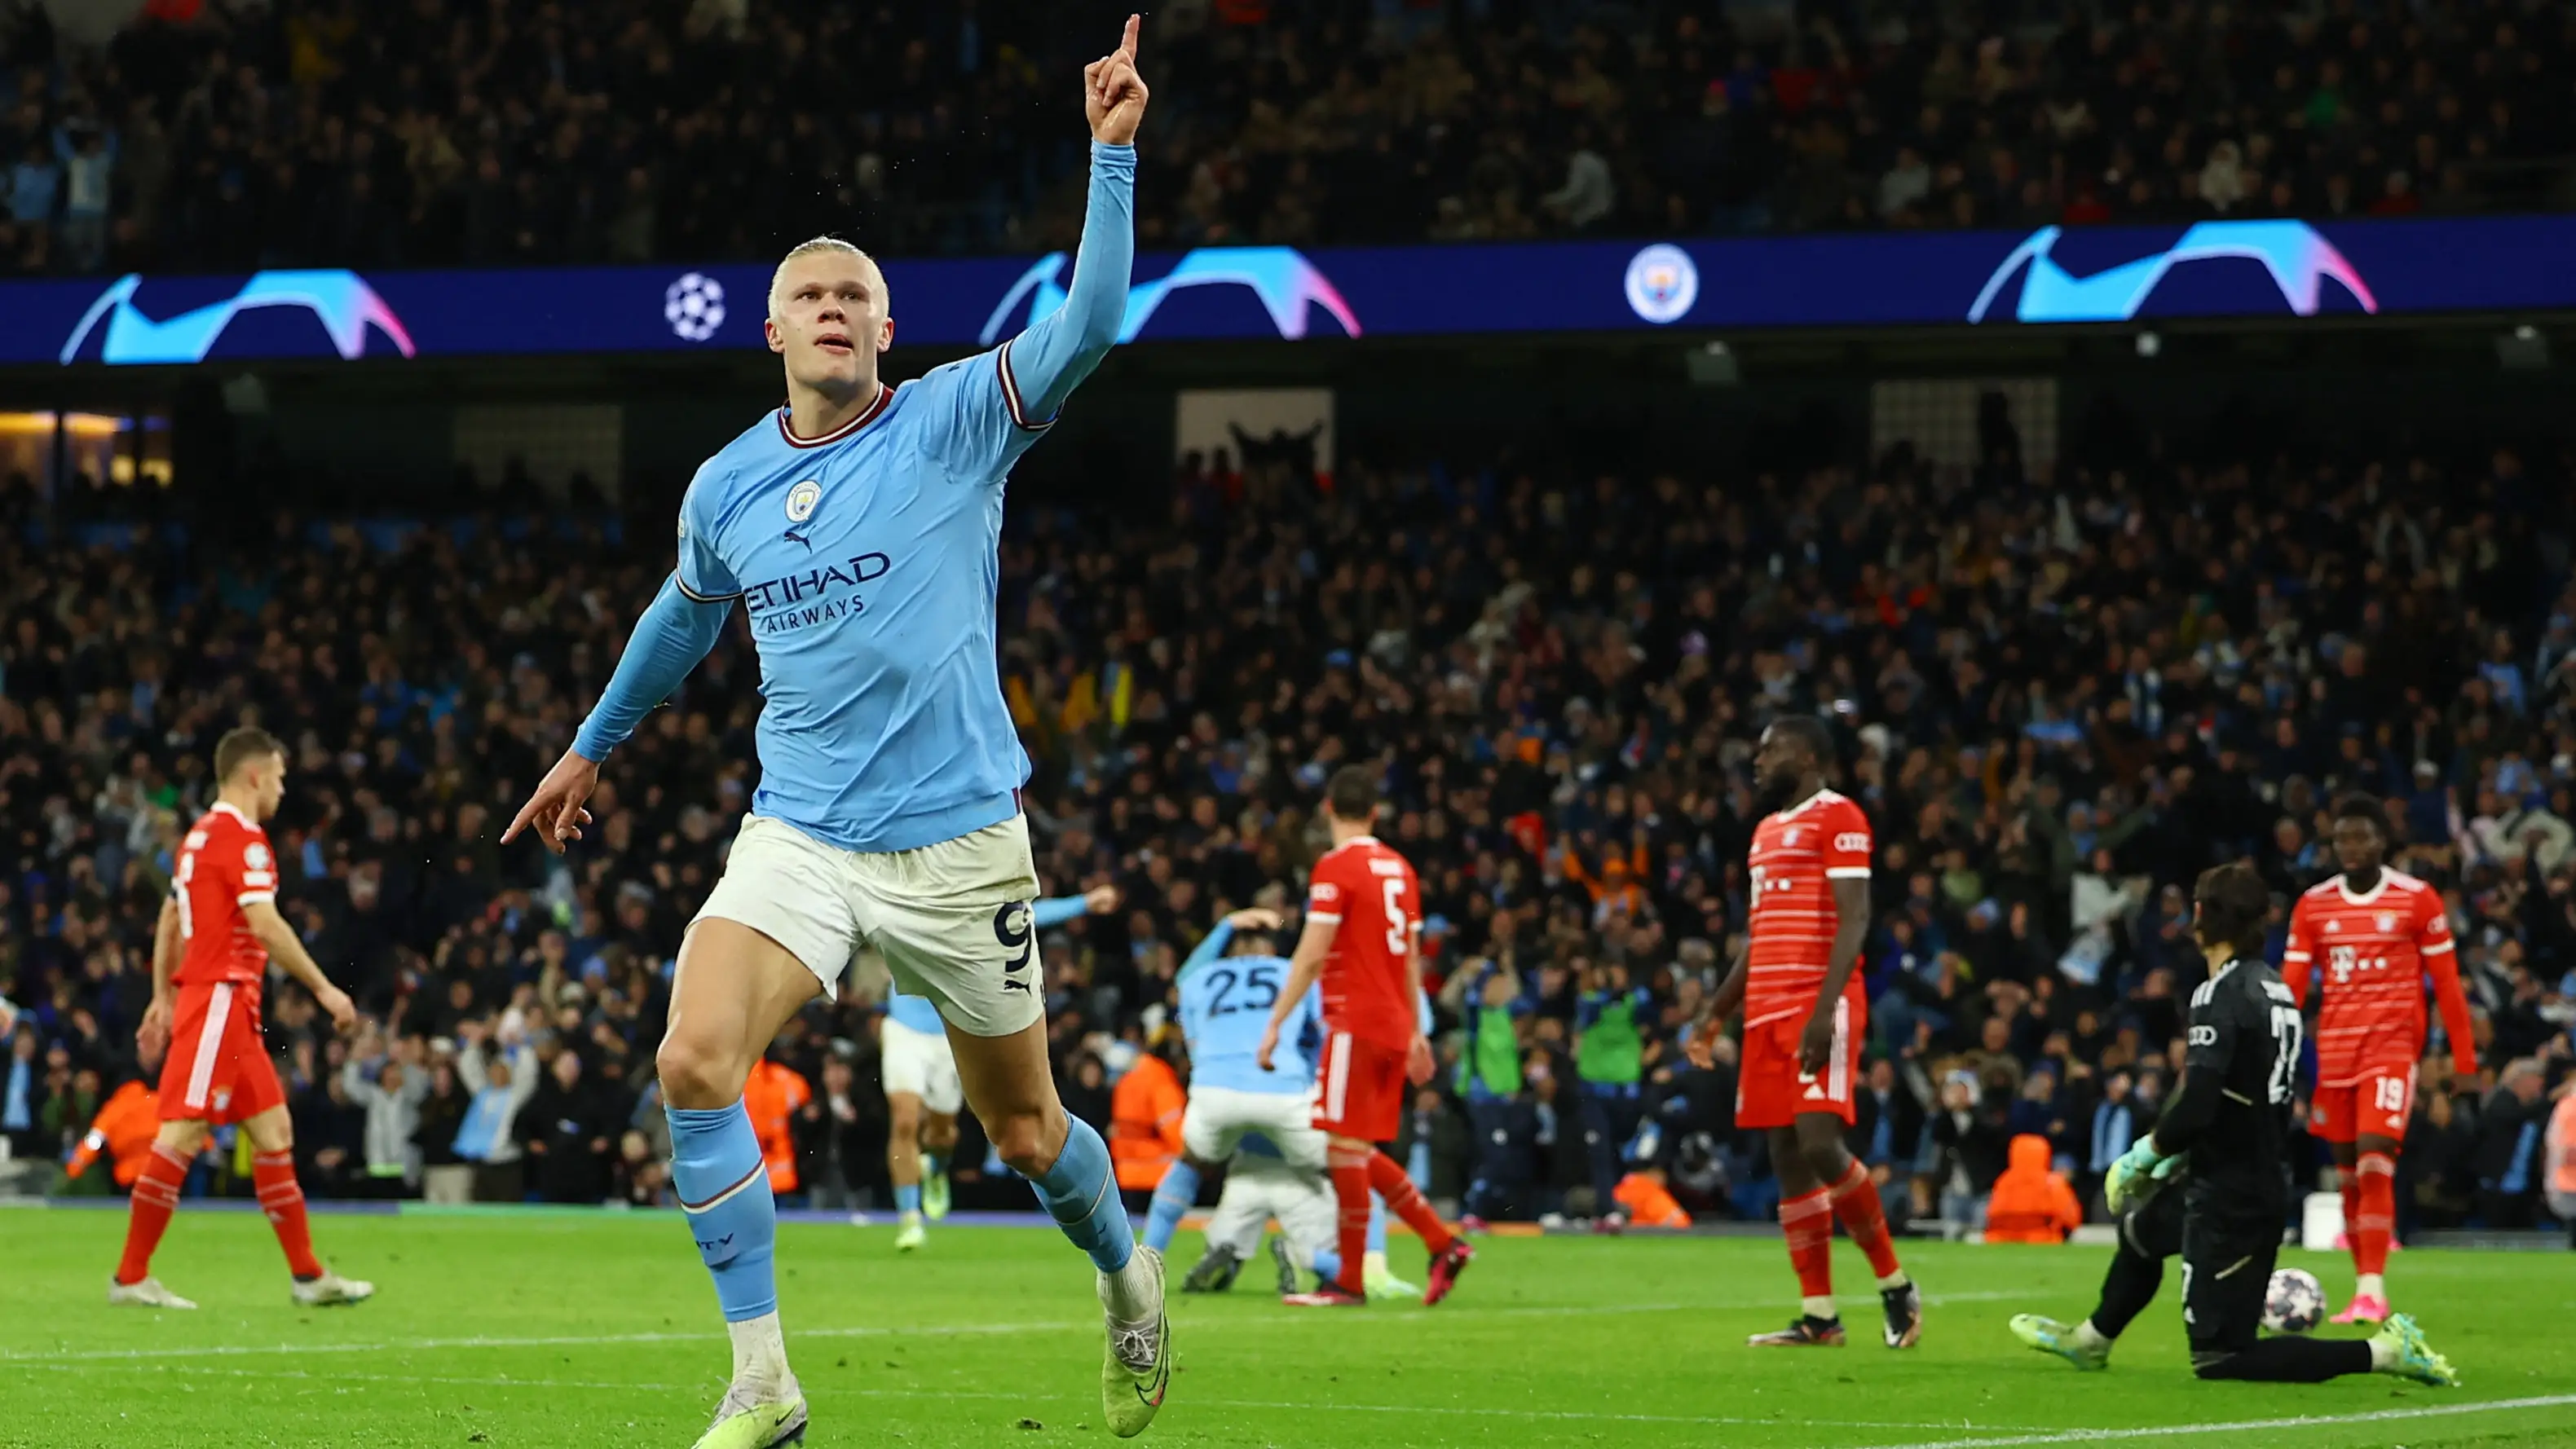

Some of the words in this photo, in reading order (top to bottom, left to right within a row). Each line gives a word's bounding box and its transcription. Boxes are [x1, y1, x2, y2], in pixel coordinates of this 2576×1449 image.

[743, 552, 891, 611] ETIHAD
[767, 595, 864, 634] AIRWAYS
[993, 901, 1031, 973] 9
[1383, 879, 1408, 956] 5
[1205, 967, 1281, 1018] 25
[2375, 1076, 2404, 1112] 19
